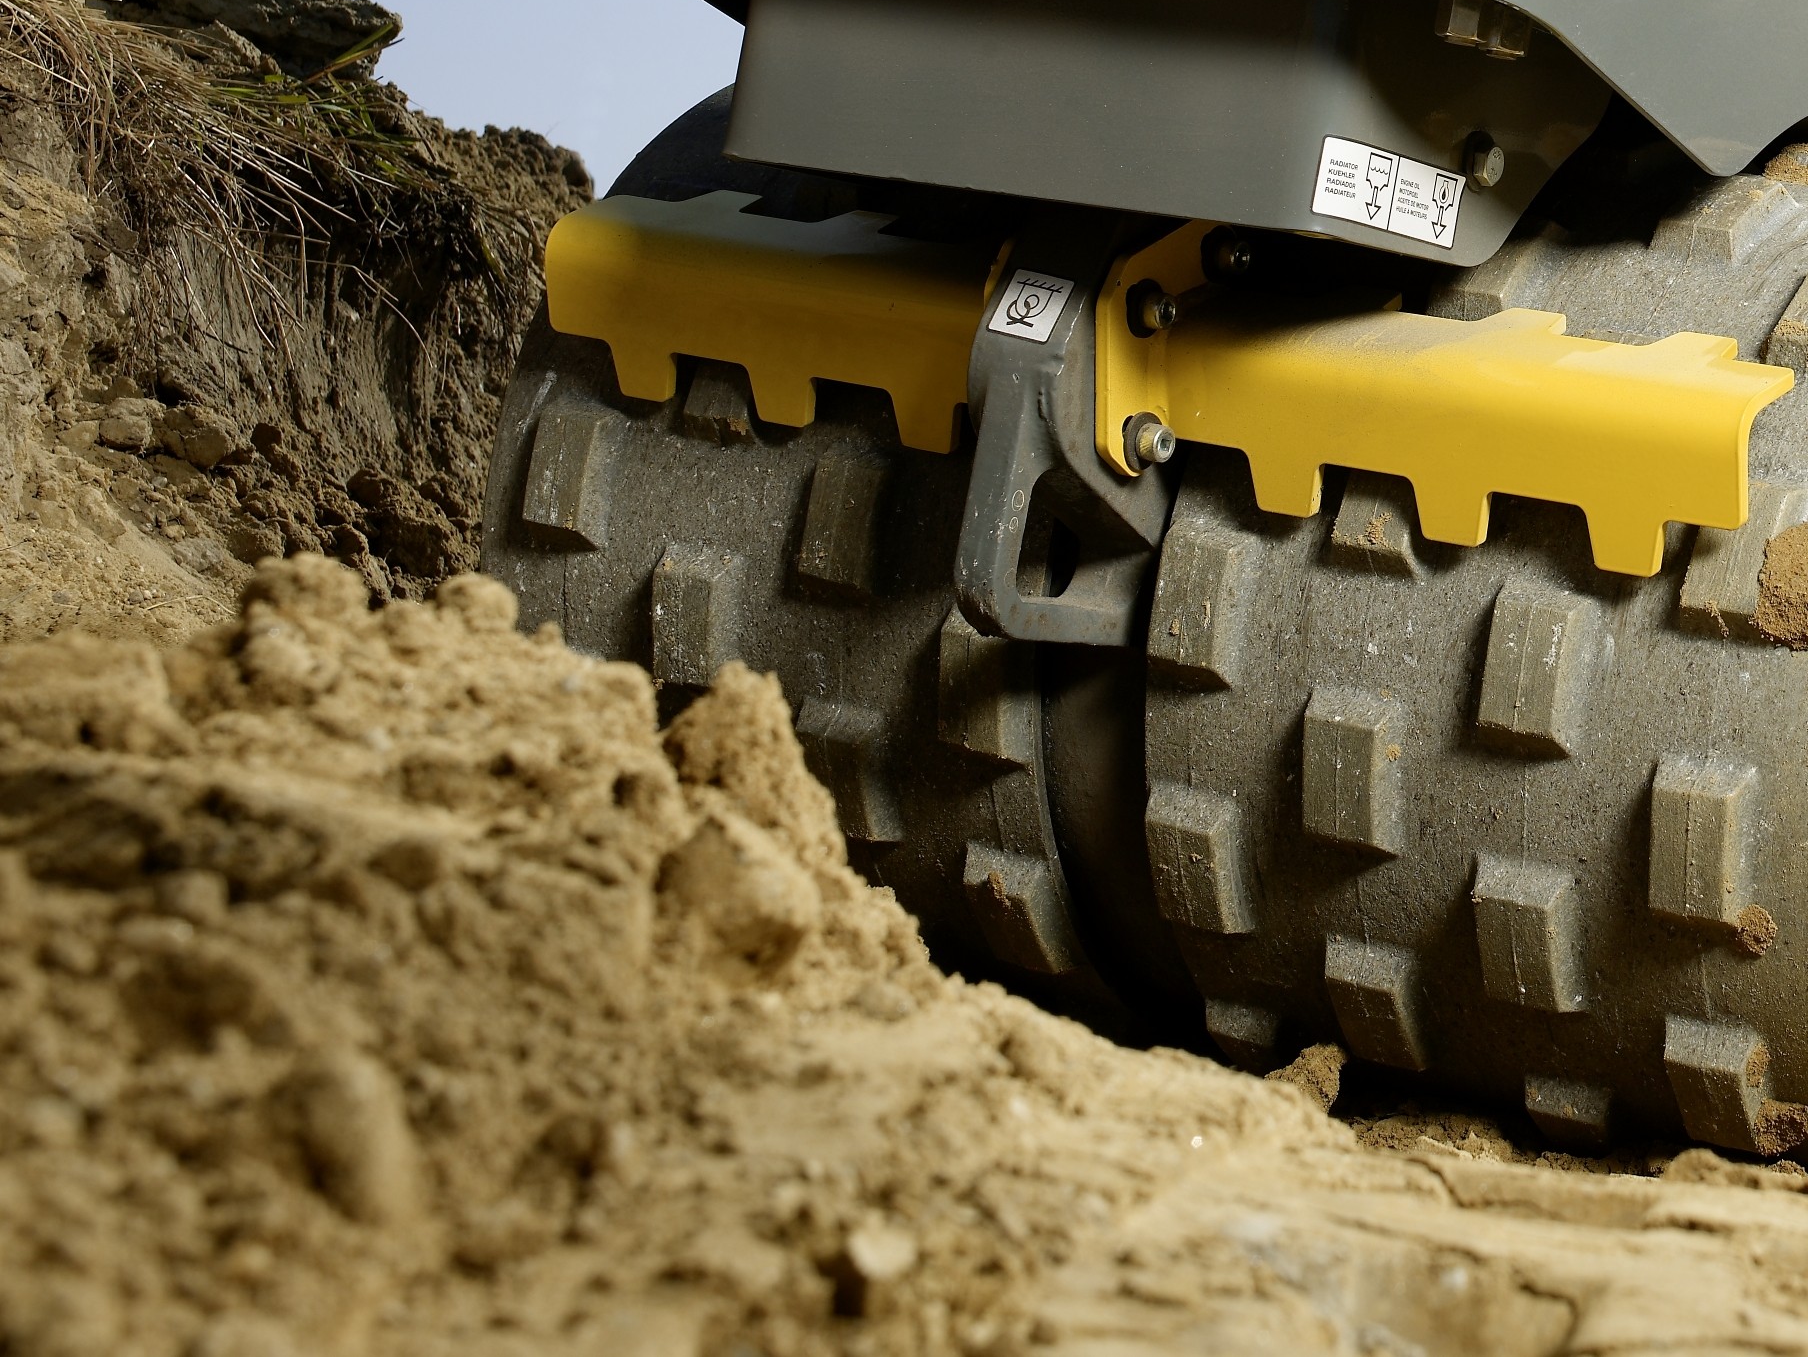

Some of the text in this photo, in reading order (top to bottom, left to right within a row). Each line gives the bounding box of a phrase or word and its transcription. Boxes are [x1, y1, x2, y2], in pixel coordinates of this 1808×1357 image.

[1330, 158, 1359, 170] RADIATOR
[1328, 168, 1356, 179] KUEHLER
[1326, 177, 1356, 189] RADIADOR
[1325, 186, 1356, 199] RADIATEUR
